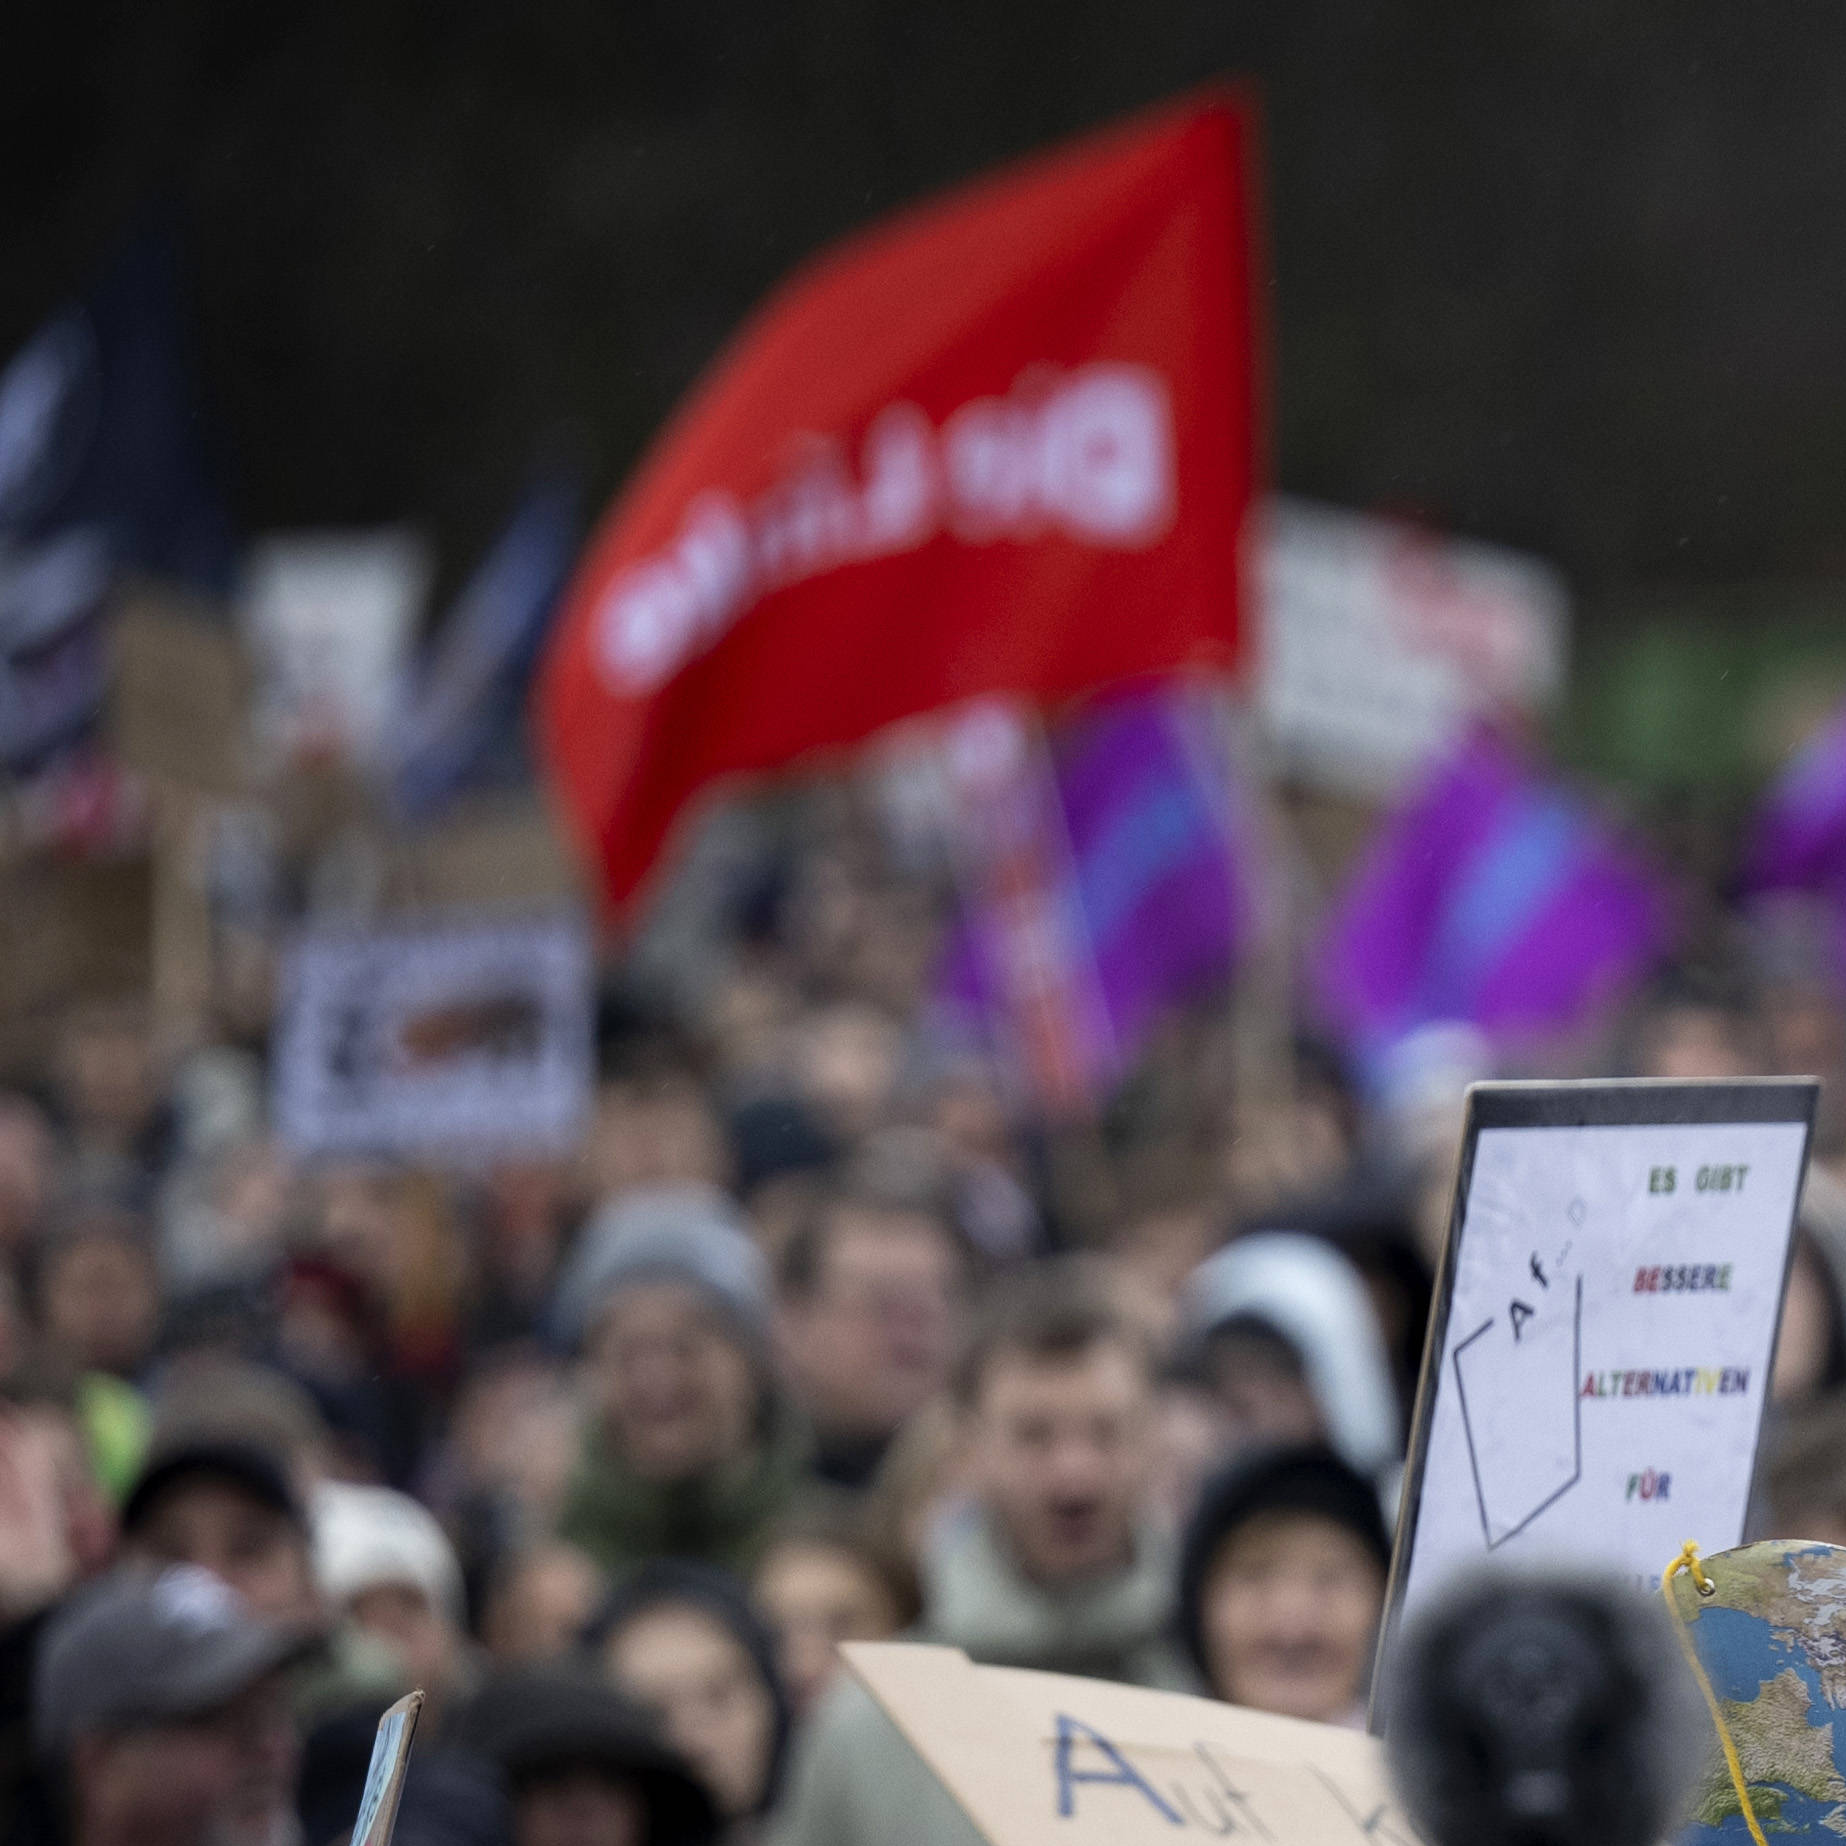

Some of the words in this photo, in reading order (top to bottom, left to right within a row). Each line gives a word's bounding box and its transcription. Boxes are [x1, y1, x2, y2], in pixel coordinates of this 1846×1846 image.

[1648, 1166, 1676, 1194] ES
[1696, 1165, 1751, 1194] GIBT
[1633, 1263, 1735, 1295] BESSERE
[1580, 1367, 1750, 1399] ALTERNATIVEN
[1625, 1467, 1673, 1503] FÜR
